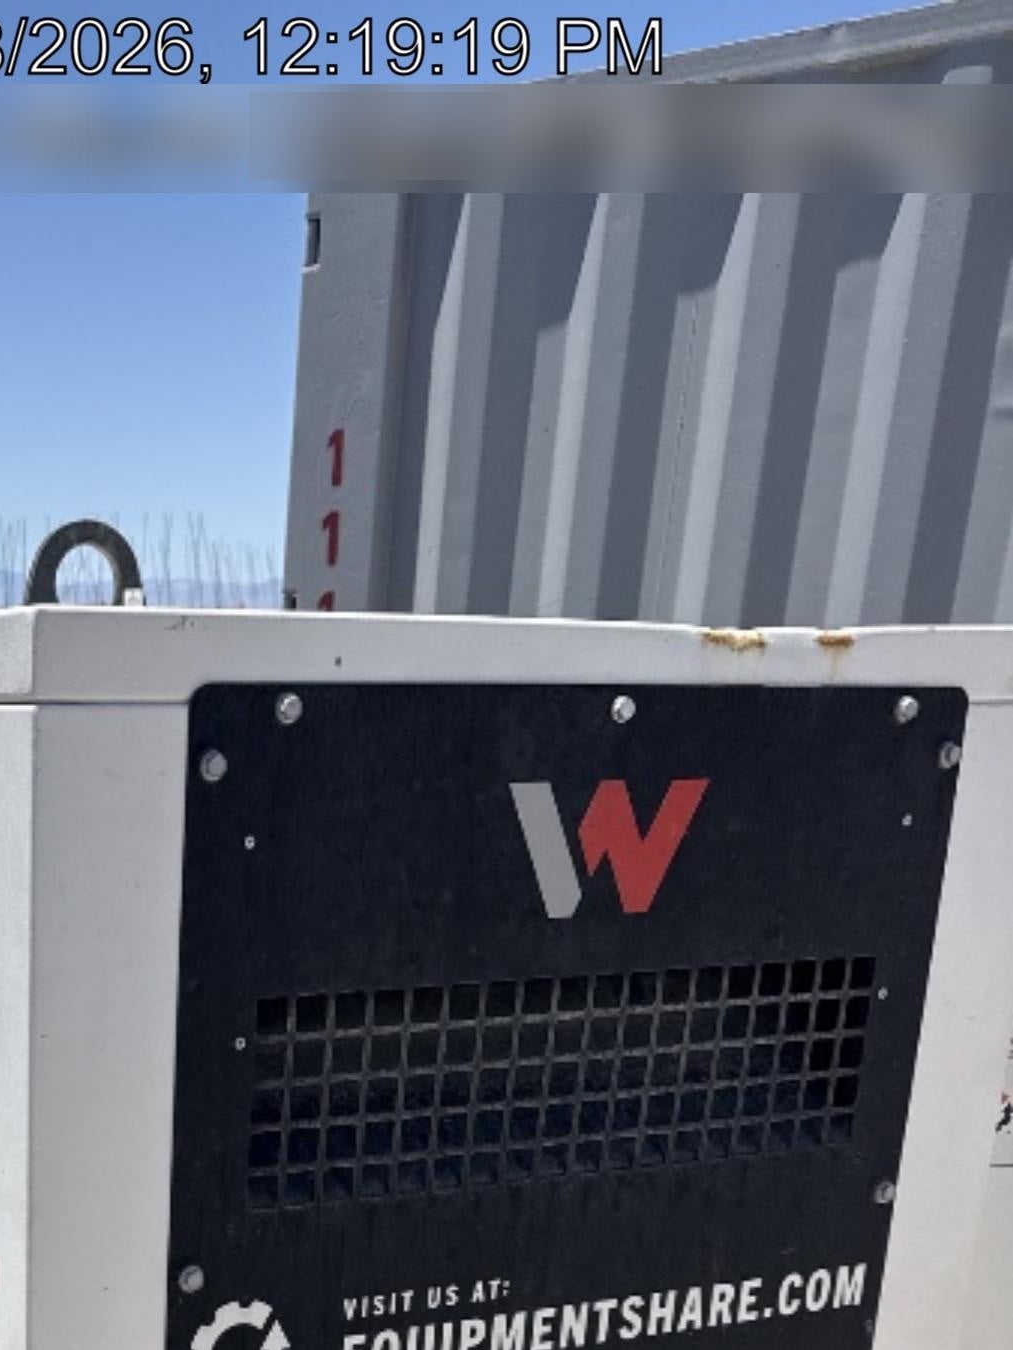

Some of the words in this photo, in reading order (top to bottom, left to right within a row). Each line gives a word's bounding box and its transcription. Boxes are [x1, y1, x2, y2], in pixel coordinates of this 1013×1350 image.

[343, 1289, 414, 1321] VISIT
[427, 1284, 459, 1309] US
[471, 1279, 510, 1304] AT:
